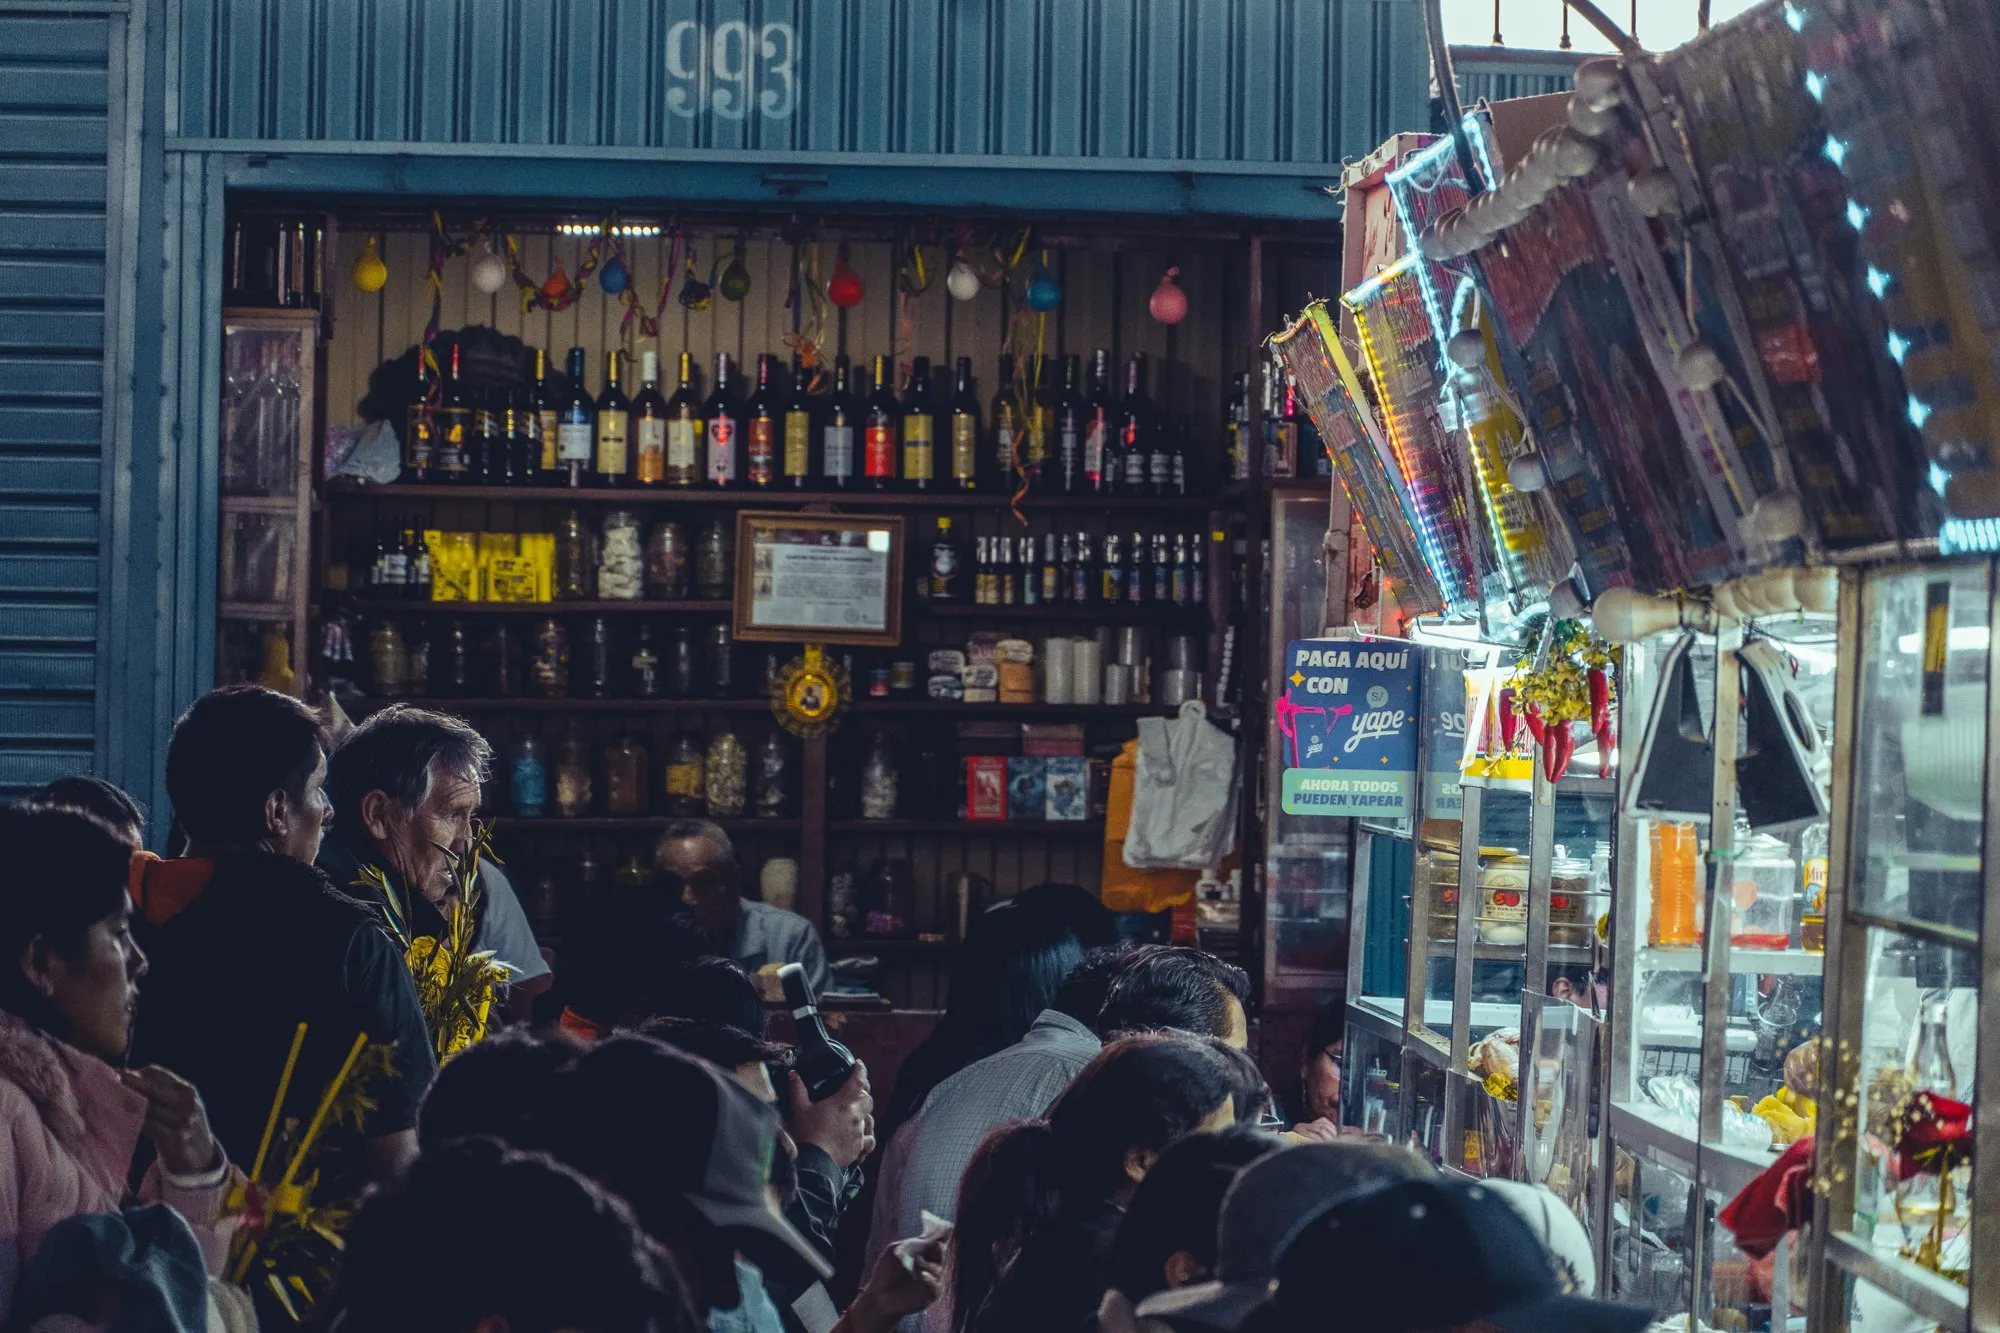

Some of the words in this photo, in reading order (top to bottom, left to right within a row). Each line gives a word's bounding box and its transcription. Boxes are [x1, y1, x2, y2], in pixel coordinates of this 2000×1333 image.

[665, 20, 798, 120] 993
[1295, 649, 1352, 669] PAGA
[1354, 648, 1411, 672] AQUÍ
[1306, 676, 1349, 695] CON
[1343, 709, 1405, 753] yape
[1300, 778, 1350, 792] AHORA
[1352, 780, 1399, 793] TODOS
[1293, 792, 1348, 806] PUEDEN
[1350, 794, 1404, 808] YAPEAR
